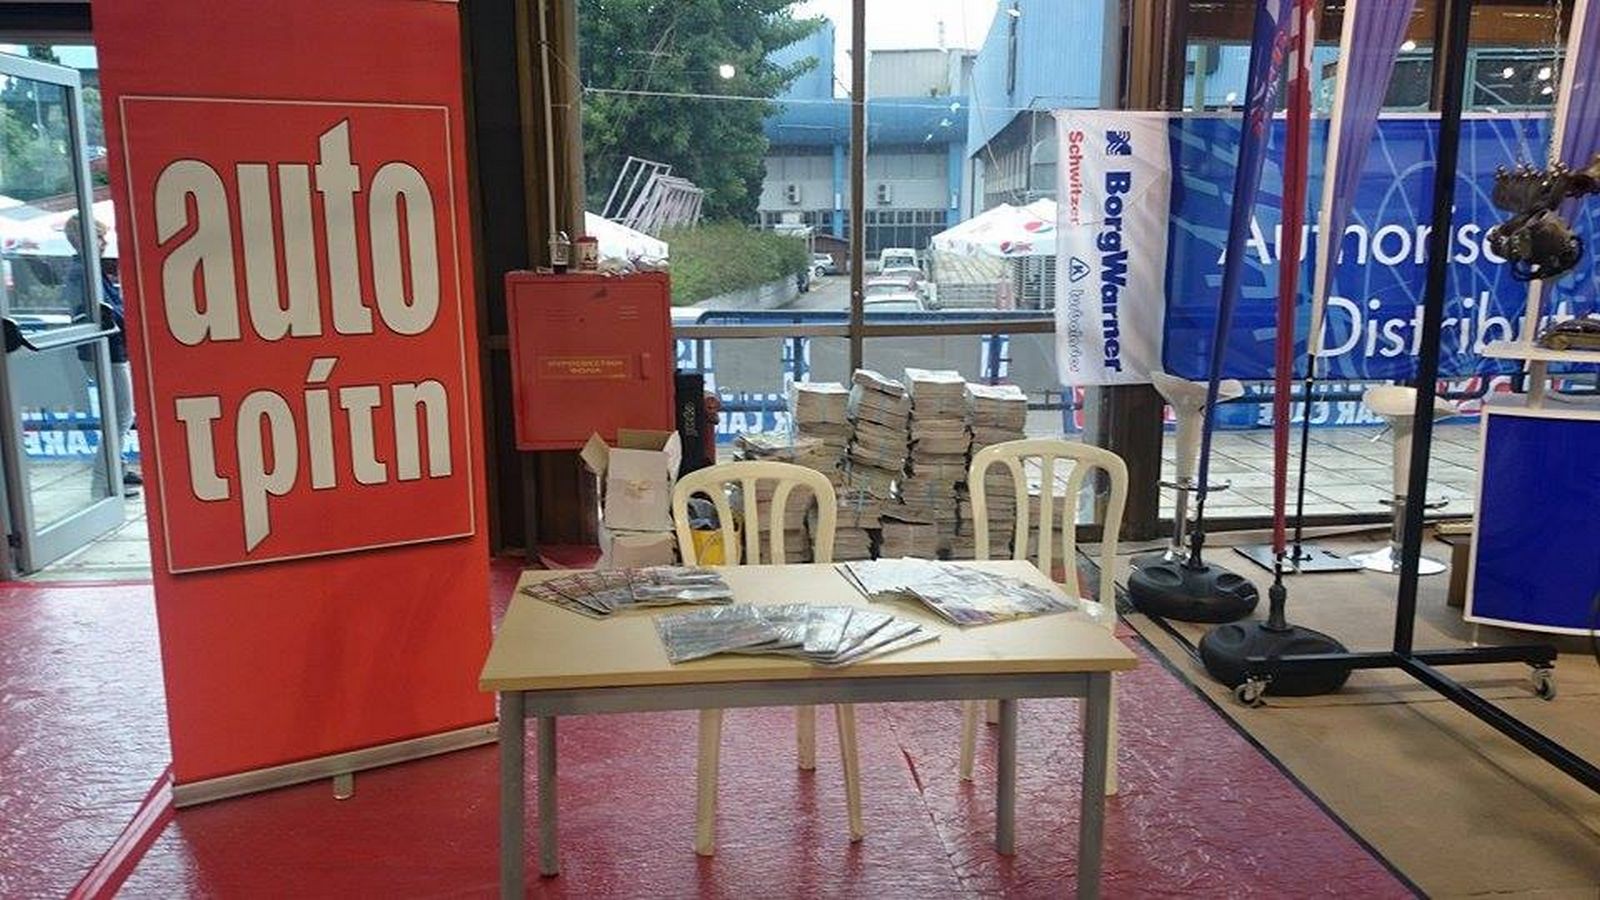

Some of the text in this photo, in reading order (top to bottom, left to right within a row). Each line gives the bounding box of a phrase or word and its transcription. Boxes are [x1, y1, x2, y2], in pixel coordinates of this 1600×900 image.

[154, 117, 441, 346] auto
[1067, 130, 1085, 226] Schwitzer
[1096, 171, 1132, 373] BorgWarner
[174, 357, 453, 555] τρίτη
